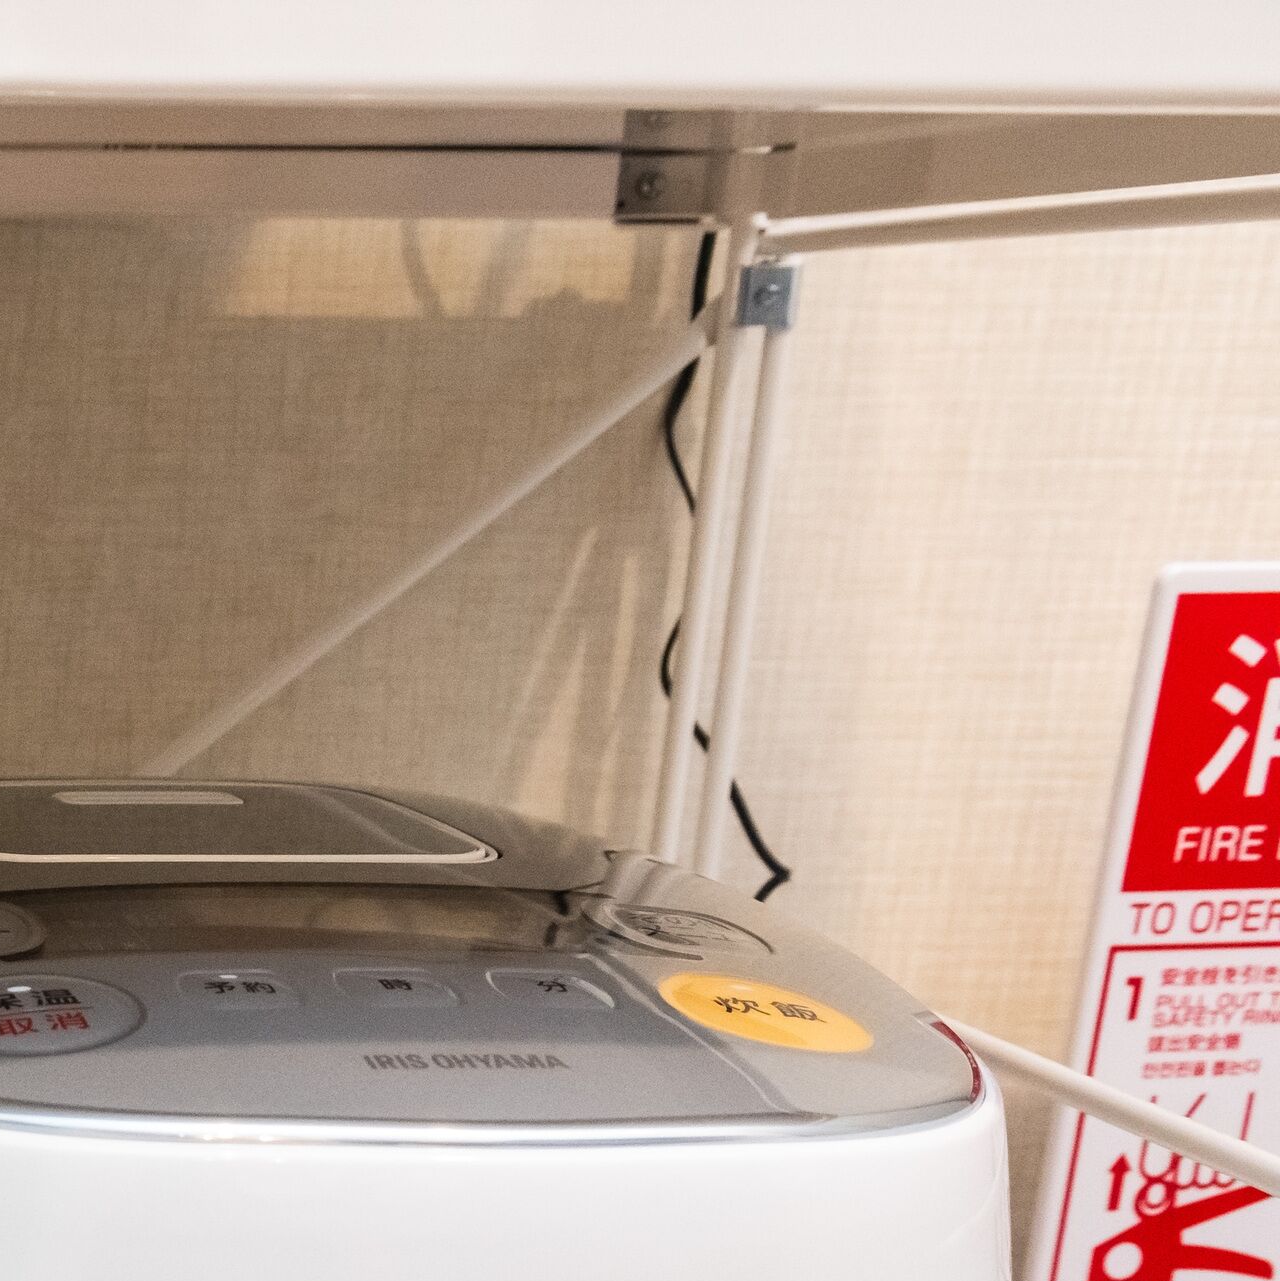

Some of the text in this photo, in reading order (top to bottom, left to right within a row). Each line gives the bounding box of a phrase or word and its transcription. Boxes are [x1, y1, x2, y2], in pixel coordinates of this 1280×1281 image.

[1173, 824, 1268, 863] FIRE
[1131, 901, 1177, 935] TO
[204, 980, 277, 995] 予約
[378, 977, 414, 992] 時
[536, 979, 569, 993] 分
[1127, 976, 1144, 1020] 1
[713, 995, 828, 1025] 炊飯
[363, 1053, 571, 1070] IRIS OHYAMA
